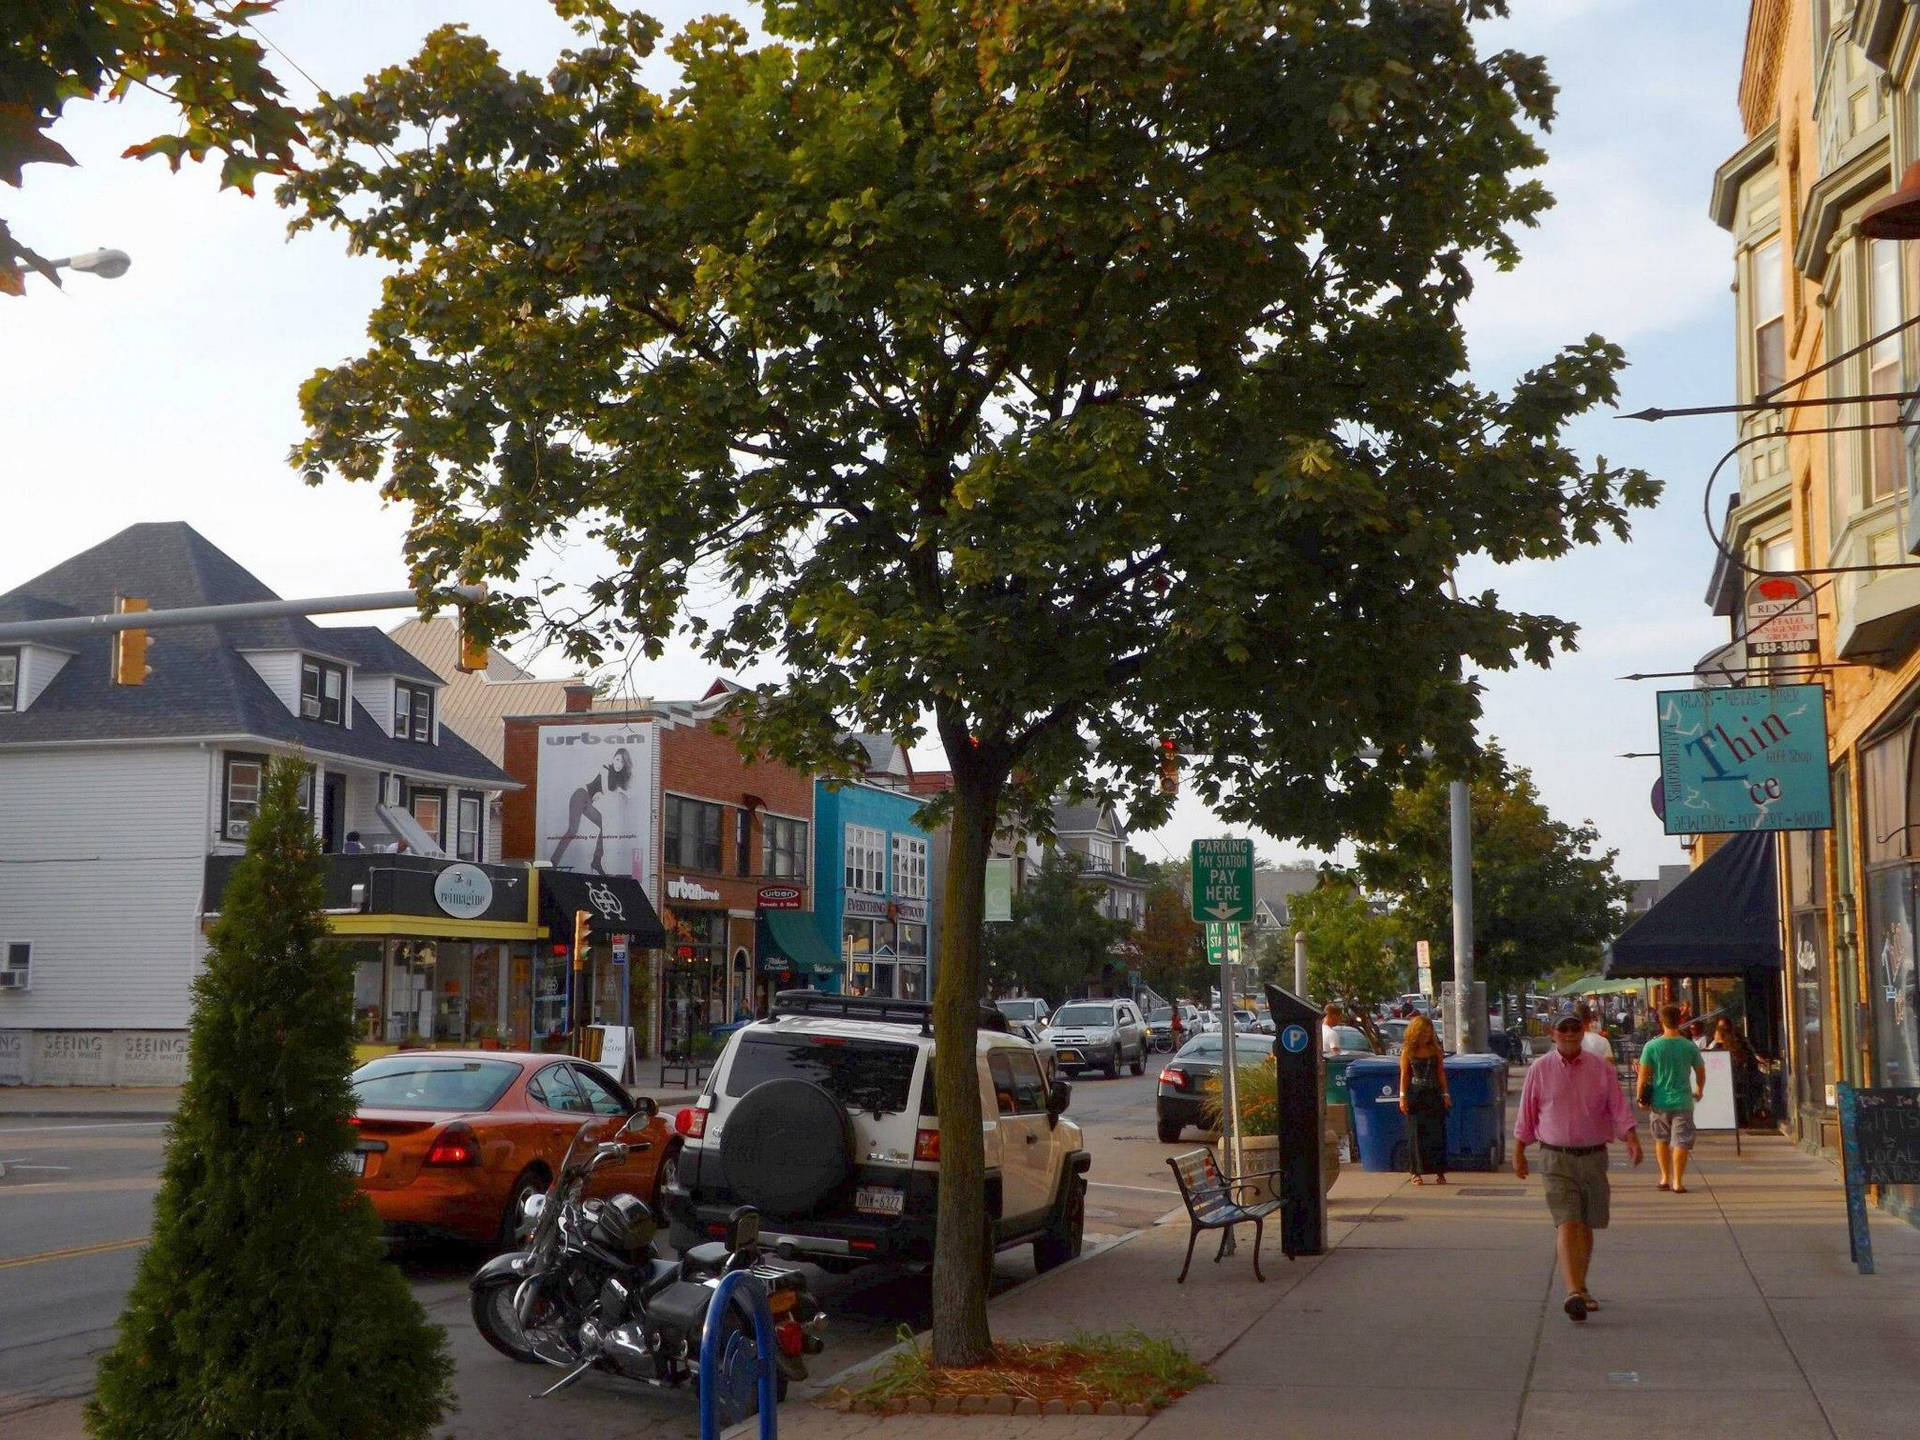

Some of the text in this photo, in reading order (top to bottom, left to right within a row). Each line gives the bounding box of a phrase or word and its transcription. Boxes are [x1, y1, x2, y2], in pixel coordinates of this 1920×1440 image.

[545, 731, 646, 746] urban
[1684, 711, 1793, 777] Thin
[1199, 840, 1248, 854] PARKING
[1198, 854, 1248, 868] PAY STATION
[1210, 869, 1237, 884] PAY
[440, 887, 486, 909] reimagine
[1205, 885, 1241, 901] HERE
[847, 897, 886, 913] EVERYTHING
[1210, 935, 1238, 947] STAON
[45, 1036, 103, 1051] SEEING
[125, 1037, 186, 1053] SEEING
